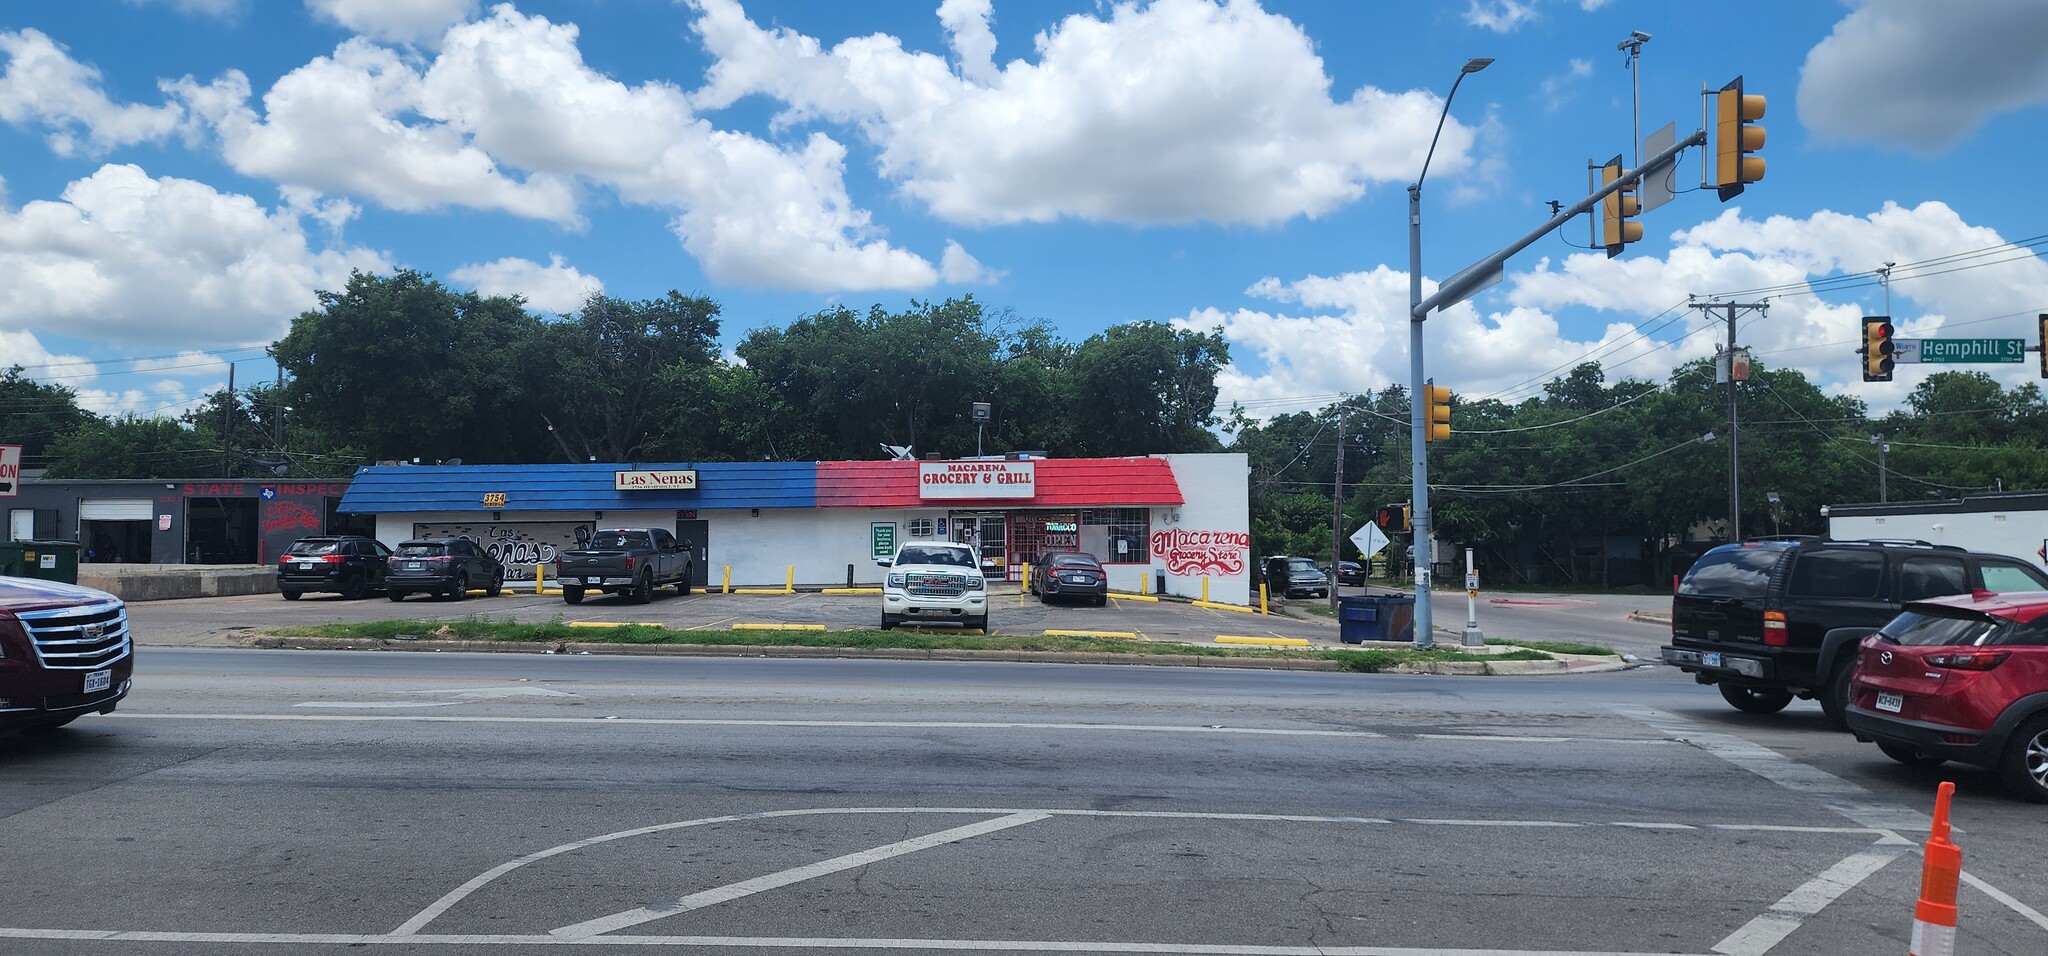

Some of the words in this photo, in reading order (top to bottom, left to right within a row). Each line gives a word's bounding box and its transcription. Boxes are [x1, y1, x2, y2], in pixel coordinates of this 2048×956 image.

[1923, 341, 1999, 358] Hemphill
[2007, 341, 2022, 355] St
[948, 464, 1006, 472] MACARENA
[620, 473, 645, 485] Las
[650, 473, 692, 485] Nenas
[923, 473, 977, 484] GROCERY
[983, 473, 991, 484] &
[997, 473, 1031, 484] GRILL
[183, 484, 244, 495] STATE
[1045, 522, 1077, 531] TOBACCO
[1045, 534, 1077, 546] OPEN
[1151, 527, 1250, 554] Macarena
[1170, 548, 1208, 567] Grocery
[1208, 546, 1237, 562] Store
